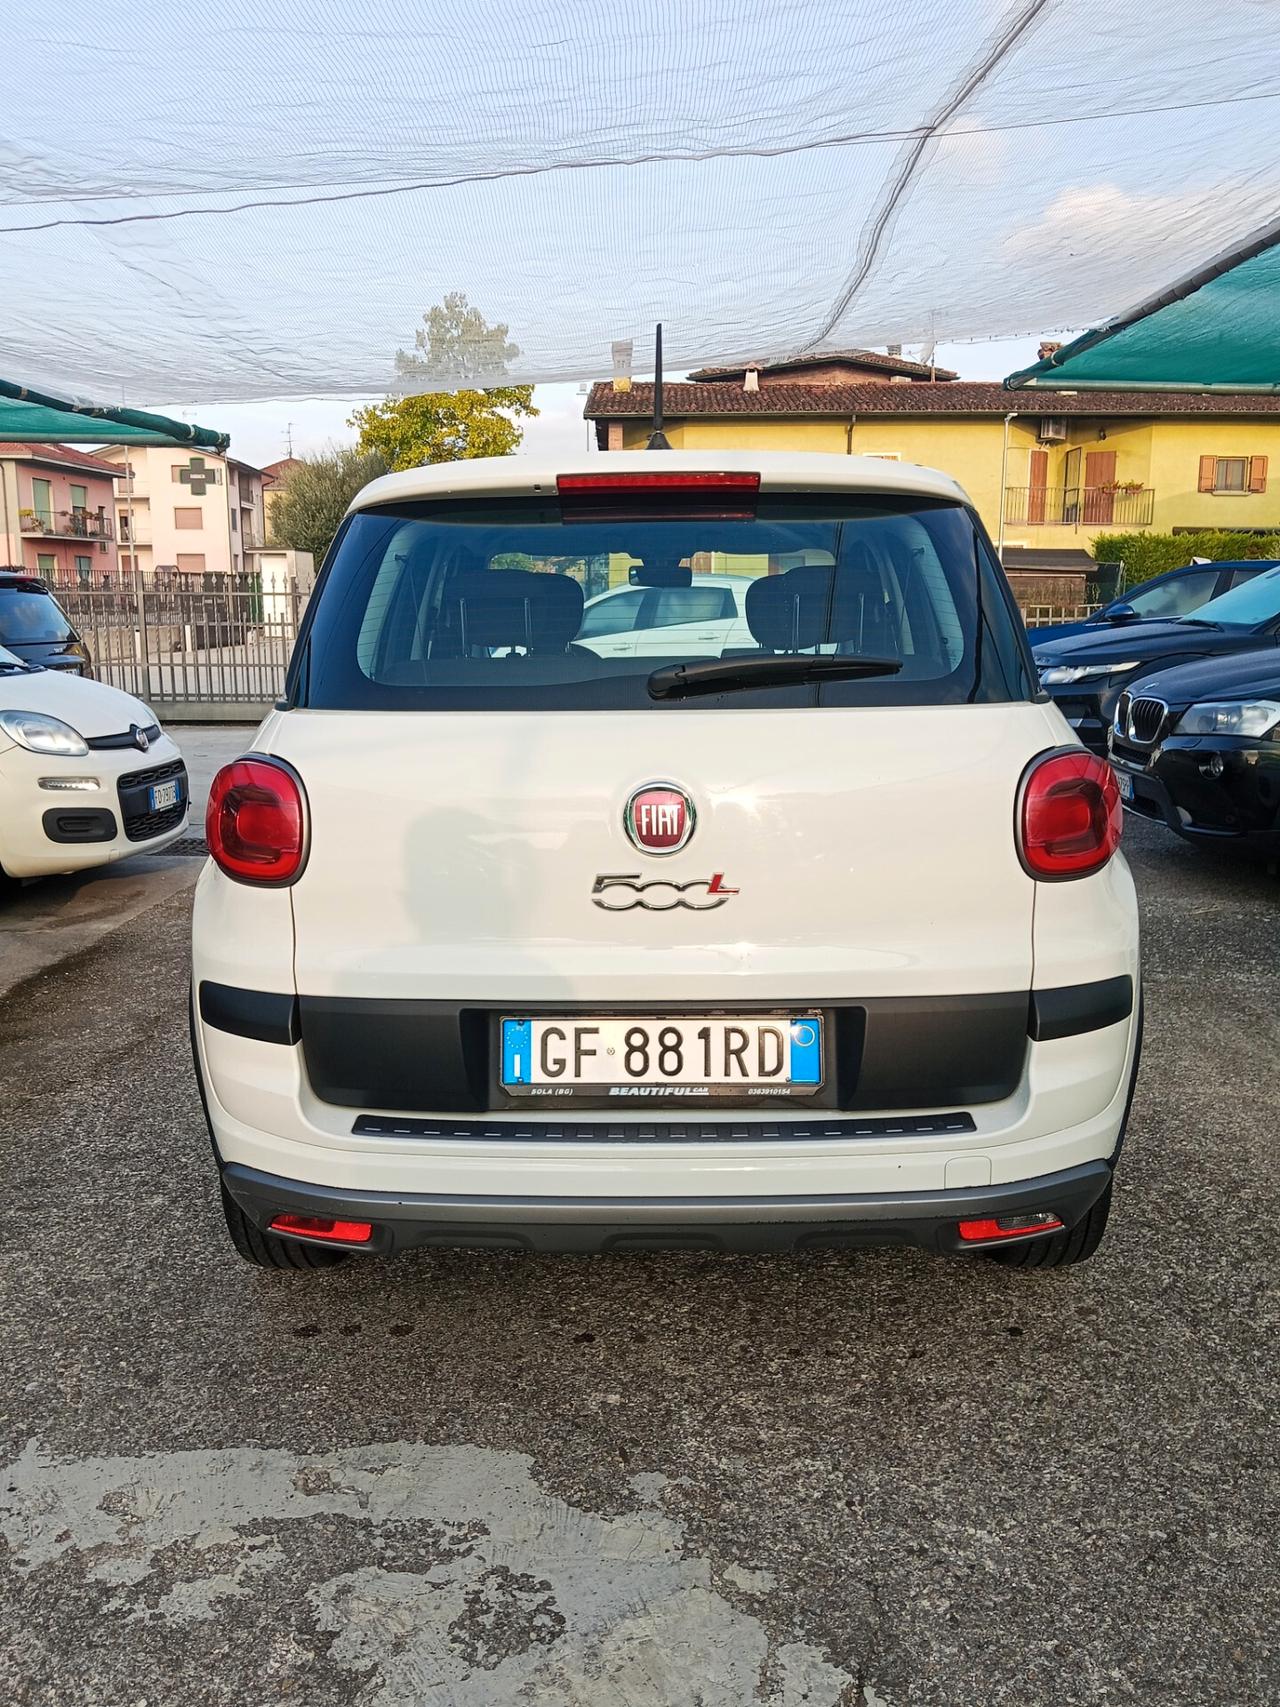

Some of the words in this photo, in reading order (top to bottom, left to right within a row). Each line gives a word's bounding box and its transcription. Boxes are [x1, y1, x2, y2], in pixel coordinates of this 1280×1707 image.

[641, 804, 682, 836] FIAT
[592, 871, 740, 912] 500L
[540, 1027, 600, 1078] GF
[624, 1026, 785, 1077] 881RD
